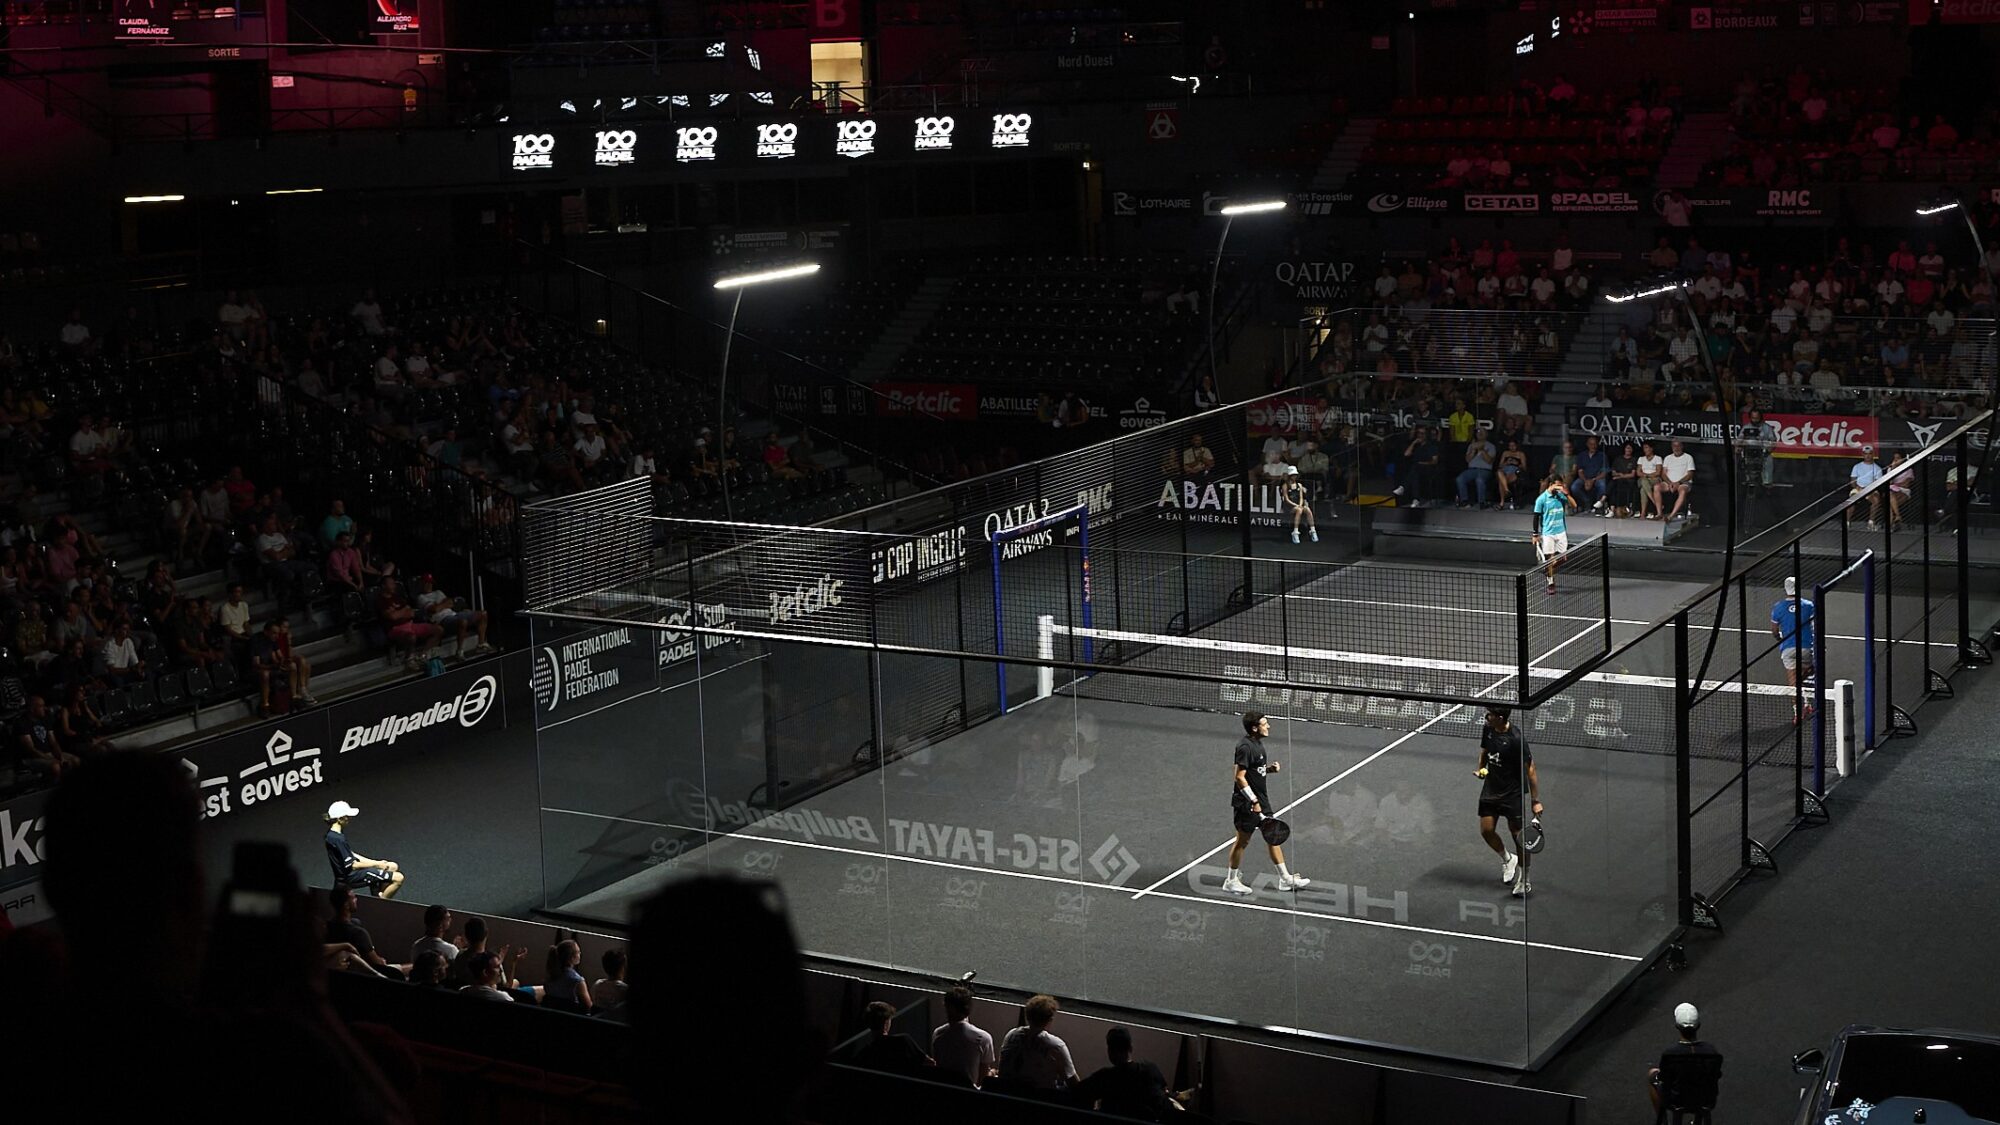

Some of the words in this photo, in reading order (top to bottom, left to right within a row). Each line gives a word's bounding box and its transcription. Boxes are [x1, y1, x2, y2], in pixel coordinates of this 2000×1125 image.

[1714, 16, 1778, 29] BORDEAUX
[208, 48, 241, 57] SORTIE
[1058, 55, 1082, 68] Nord
[1085, 54, 1113, 67] Ouest
[836, 120, 877, 139] 100
[915, 116, 955, 135] 100
[992, 113, 1031, 132] 100
[595, 130, 637, 149] 100
[676, 126, 718, 146] 100
[757, 123, 798, 142] 100
[992, 133, 1029, 145] PADEL
[513, 134, 555, 153] 100
[757, 143, 795, 155] PADEL
[836, 141, 875, 152] PADEL
[915, 136, 952, 148] PADEL
[513, 155, 553, 167] PADEL
[595, 151, 635, 163] PADEL
[676, 148, 716, 159] PADEL
[1140, 199, 1192, 209] LOTHAIRE
[1311, 192, 1353, 201] Forestier
[1406, 195, 1448, 212] Ellipse
[1467, 196, 1537, 209] CETAB
[1561, 193, 1638, 204] PADEL
[1767, 190, 1811, 207] RMC
[1304, 306, 1328, 315] SORT
[888, 389, 961, 414] Betclic
[1120, 415, 1166, 428] eovest
[1580, 414, 1653, 435] QATAR
[1701, 423, 1741, 439] INGEEC
[1763, 420, 1864, 447] Betclic
[1158, 479, 1285, 514] ABATILL
[1250, 517, 1282, 527] ATURE
[1001, 528, 1053, 562] AIRWAYS
[887, 540, 914, 580] CAP
[562, 627, 632, 663] INTERNATIONAL
[659, 640, 697, 666] PADEL
[564, 657, 594, 682] PADEL
[565, 667, 620, 701] FEDERATION
[339, 694, 462, 754] Bullpadel
[240, 757, 324, 807] eovest
